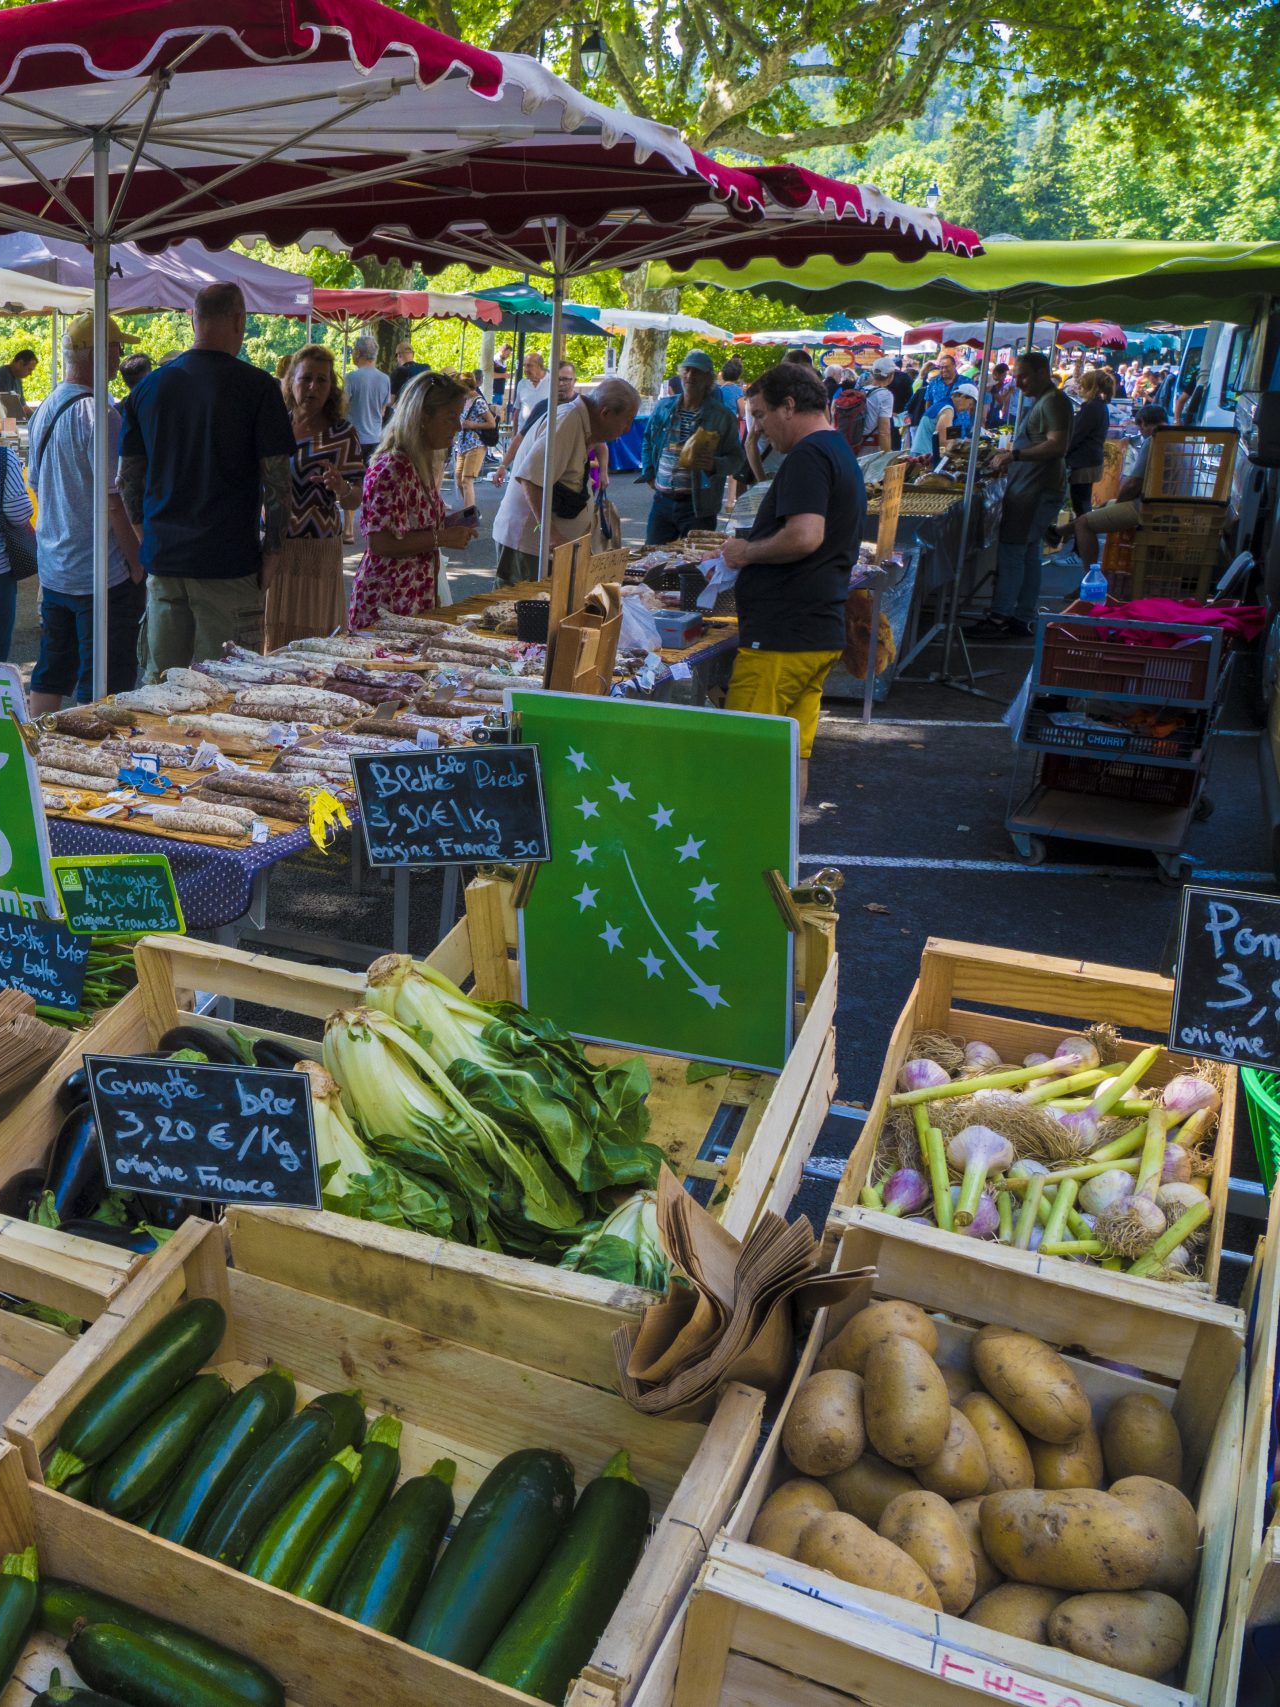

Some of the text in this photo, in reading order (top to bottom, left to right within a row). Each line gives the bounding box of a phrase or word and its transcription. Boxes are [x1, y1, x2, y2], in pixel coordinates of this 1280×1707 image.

[369, 759, 528, 799] Blette Pieds
[436, 755, 467, 775] bio
[370, 837, 540, 864] origine France 30
[63, 874, 78, 885] AB
[72, 912, 177, 931] origine France 30
[56, 934, 89, 964] bio
[10, 975, 56, 1001] France
[59, 990, 77, 1006] 30
[1180, 1023, 1274, 1058] origine
[235, 1078, 297, 1117] bio
[115, 1153, 280, 1199] origine France
